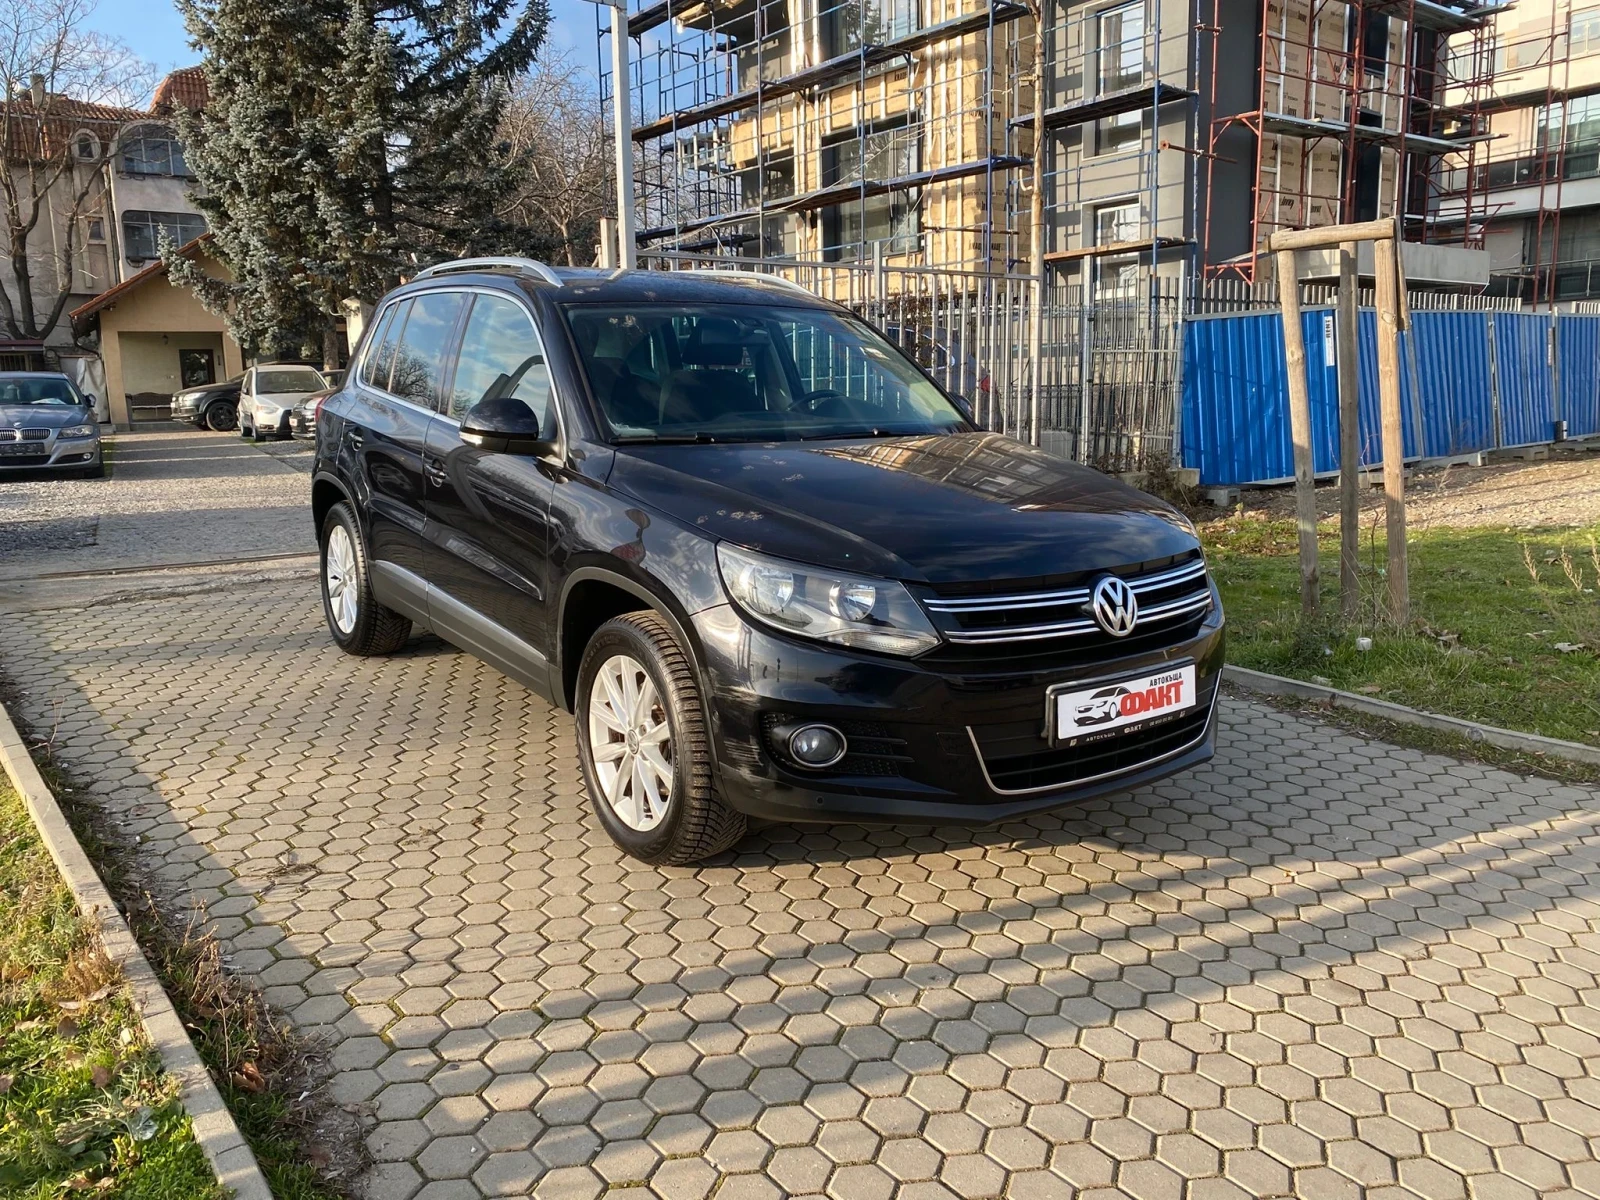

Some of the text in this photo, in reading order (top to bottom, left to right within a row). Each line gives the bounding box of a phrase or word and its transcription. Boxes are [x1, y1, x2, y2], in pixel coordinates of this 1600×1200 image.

[1149, 672, 1183, 687] АВТОКЪЩА
[1121, 681, 1184, 716] ФАКТ
[1124, 723, 1143, 734] ФАКТ
